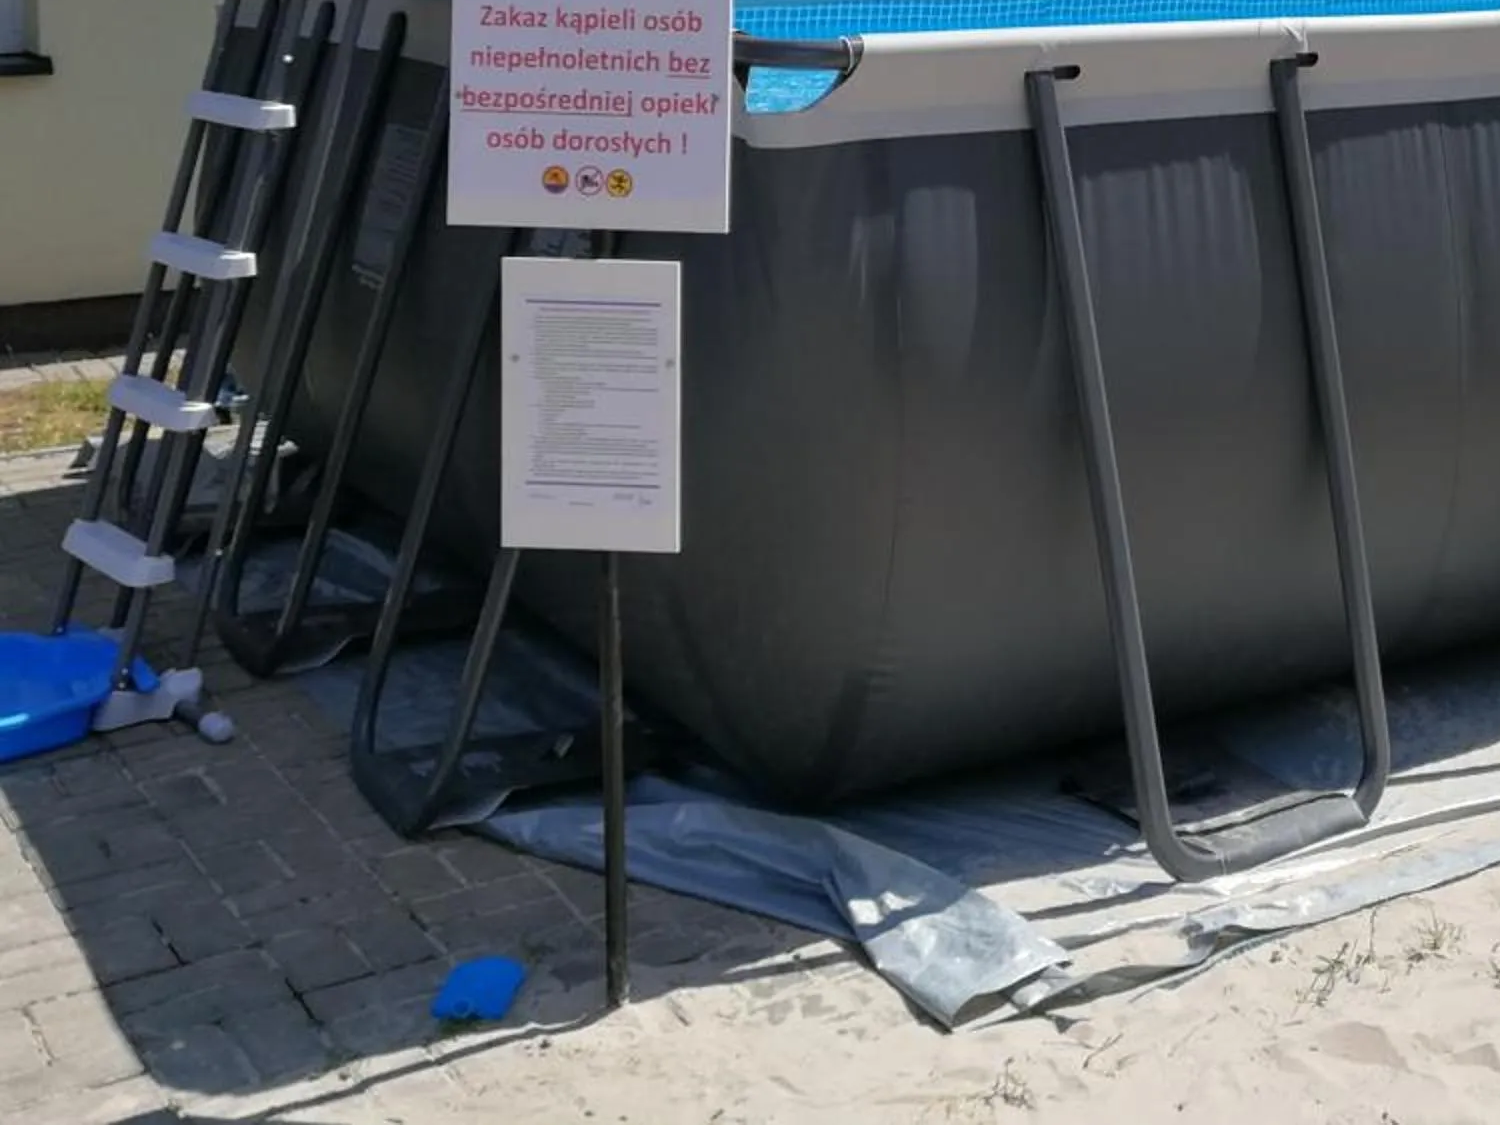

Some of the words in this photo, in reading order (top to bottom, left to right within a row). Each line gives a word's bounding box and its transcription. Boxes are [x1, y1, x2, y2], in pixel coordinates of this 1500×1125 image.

[479, 5, 547, 27] Zakaz
[556, 7, 635, 35] kąpieli
[643, 9, 702, 32] osób
[471, 46, 659, 73] niepełnoletnich
[668, 52, 710, 74] bez
[461, 84, 633, 116] bezpośredniej
[486, 127, 544, 150] osób
[552, 130, 671, 157] dorosłych
